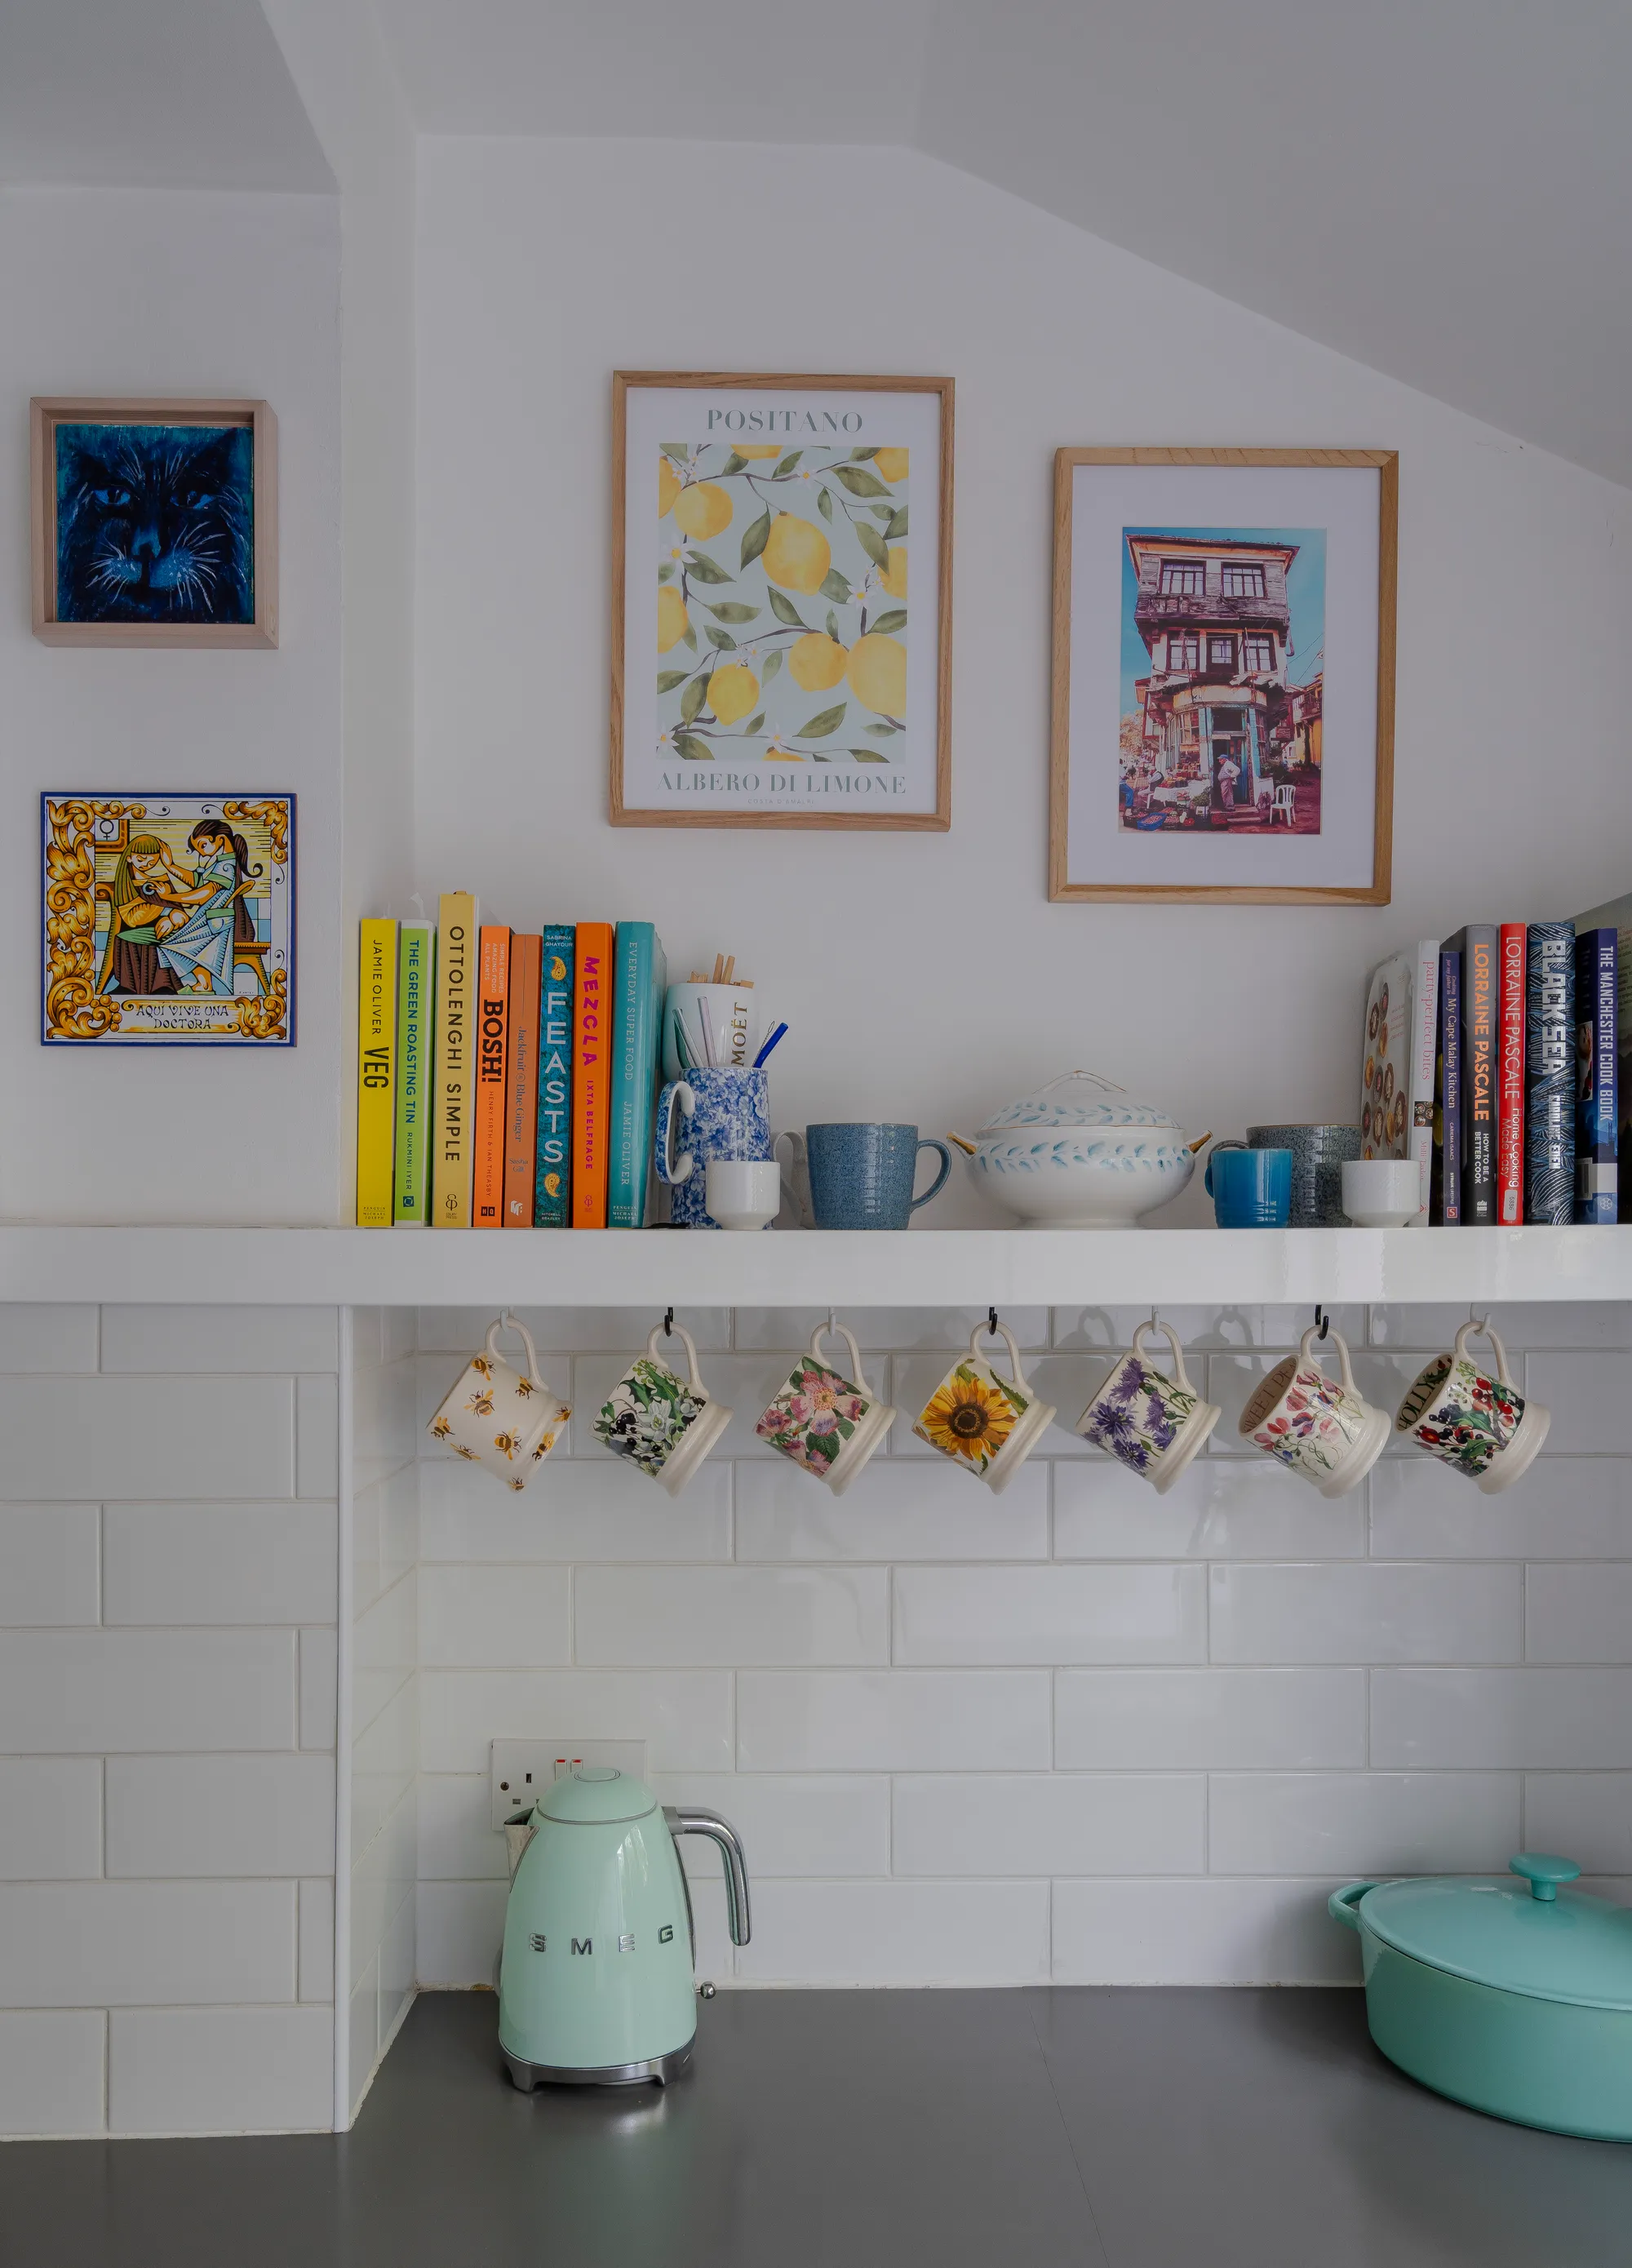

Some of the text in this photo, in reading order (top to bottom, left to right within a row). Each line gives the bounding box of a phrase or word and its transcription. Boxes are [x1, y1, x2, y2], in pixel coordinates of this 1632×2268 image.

[706, 409, 863, 433] POSITANO
[657, 772, 906, 793] ALBERO DI LIMONE
[372, 940, 382, 1035] JAMIE OLIVER
[1600, 946, 1613, 968] THE
[153, 1018, 211, 1029] DOCTORA
[168, 1005, 200, 1016] VIVE
[205, 1005, 228, 1017] UNA
[406, 940, 419, 1124] THE GREEN ROASTING TIN
[445, 926, 464, 1161] OTTOLENGHI SIMPLE
[481, 999, 503, 1082] BOSH!
[582, 956, 601, 1067] MEZCLA
[624, 942, 637, 1081] EVERYDAY SUPER FOOD
[730, 1002, 747, 1067] MOËT
[1421, 961, 1435, 1080] party-perfect bites
[1475, 943, 1489, 1121] LORRAINE PASCALE
[1505, 937, 1521, 1099] LORRAINE PASCALE
[1542, 940, 1566, 1074] BLACK SEA
[1600, 972, 1613, 1049] MANCHESTER
[363, 1047, 389, 1088] VEG
[517, 1026, 527, 1071] Jackfruit
[543, 992, 568, 1163] FEASTS
[1446, 998, 1457, 1108] My Cape Malay Kitchen
[1600, 1054, 1612, 1085] COOK
[512, 1108, 524, 1143] Ginger
[516, 1084, 525, 1106] Blue
[585, 1081, 594, 1170] IXTA BELFRAGE
[1549, 1095, 1560, 1169] CAROLINE EDEN
[1600, 1090, 1613, 1121] BOOK
[621, 1102, 632, 1185] JAMIE OLIVER
[1483, 1154, 1489, 1164] TO
[1483, 1165, 1489, 1175] BE
[1501, 1118, 1512, 1178] Made Easy
[1509, 1108, 1522, 1187] Home Cooking
[529, 1924, 674, 1955] SMEG
